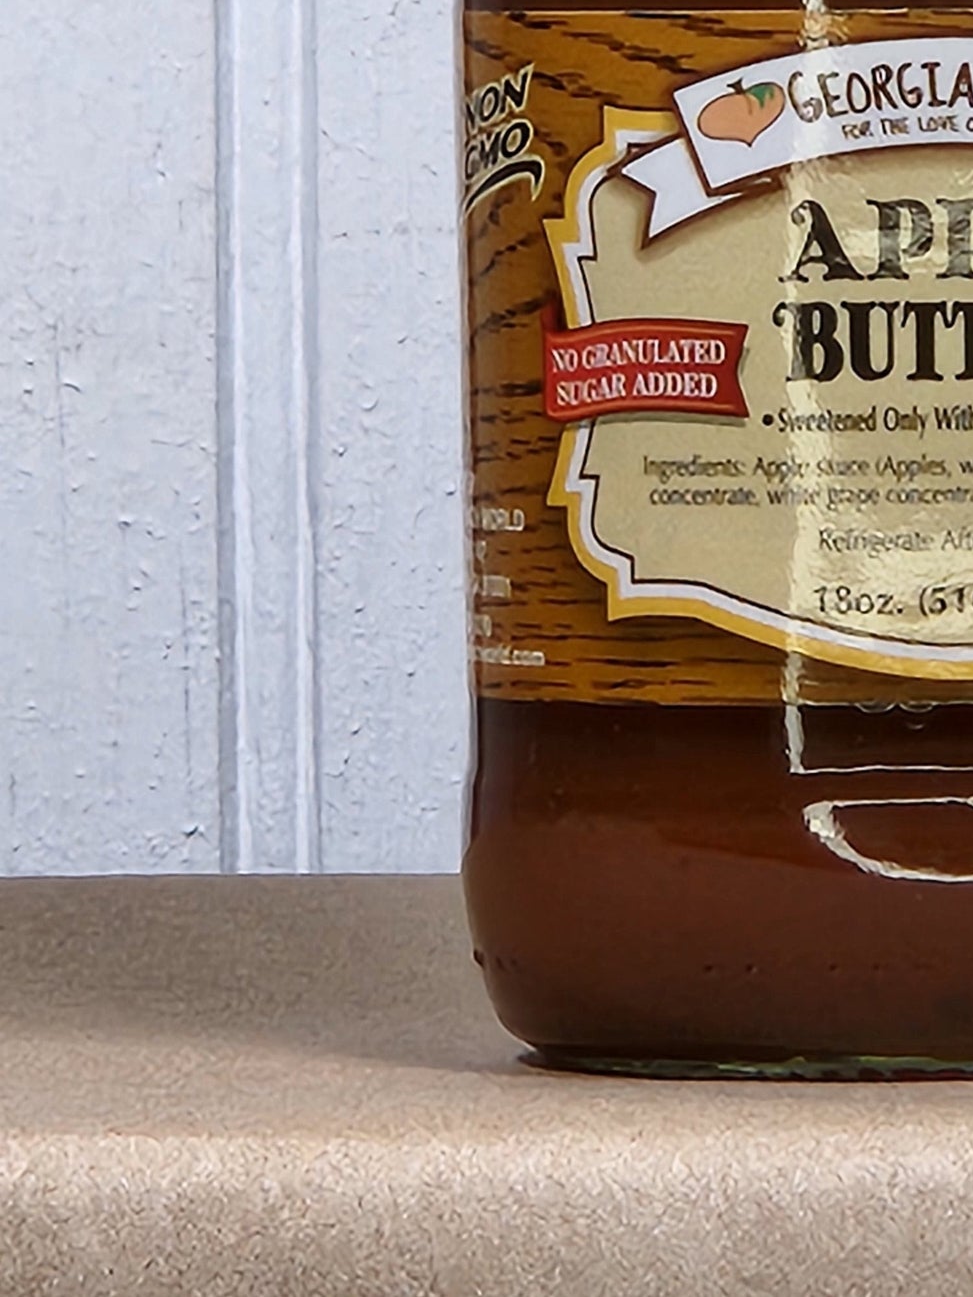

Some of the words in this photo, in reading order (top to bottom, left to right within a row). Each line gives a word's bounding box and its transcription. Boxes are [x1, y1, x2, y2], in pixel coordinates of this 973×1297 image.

[841, 123, 874, 140] FOR
[881, 118, 911, 136] THE
[917, 117, 961, 133] LOVE
[552, 348, 578, 372] NO
[582, 339, 726, 369] GRANULATED
[556, 374, 627, 406] SUGAR
[632, 371, 718, 398] ADDED
[883, 405, 929, 440] Only
